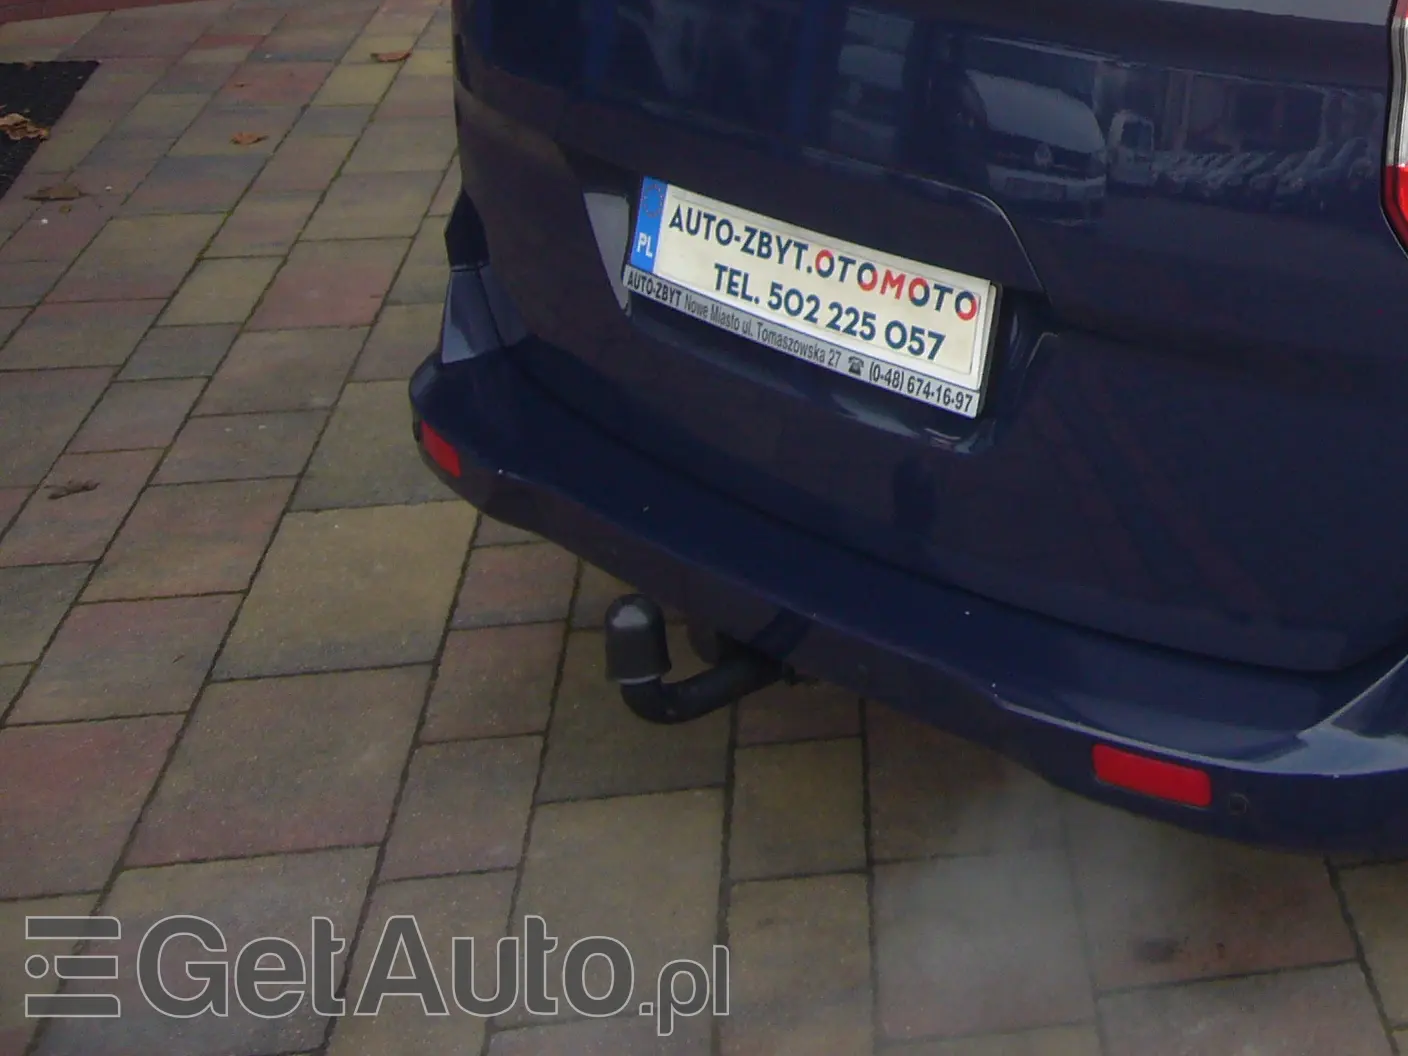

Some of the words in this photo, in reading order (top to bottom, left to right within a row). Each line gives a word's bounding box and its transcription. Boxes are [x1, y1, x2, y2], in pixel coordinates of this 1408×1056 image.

[636, 232, 653, 259] PL
[668, 204, 978, 321] AUTO-ZBYT.OTOMOTO
[627, 270, 683, 307] AUTO-ZBYT
[684, 295, 709, 319] Nowe
[710, 304, 740, 332] Miasto
[742, 319, 754, 338] ul.
[756, 321, 826, 364] Tomaszowska
[827, 348, 842, 368] 27
[714, 262, 760, 305] TEL.
[768, 281, 821, 324] 502
[826, 301, 876, 341] 225
[884, 319, 946, 361] 057
